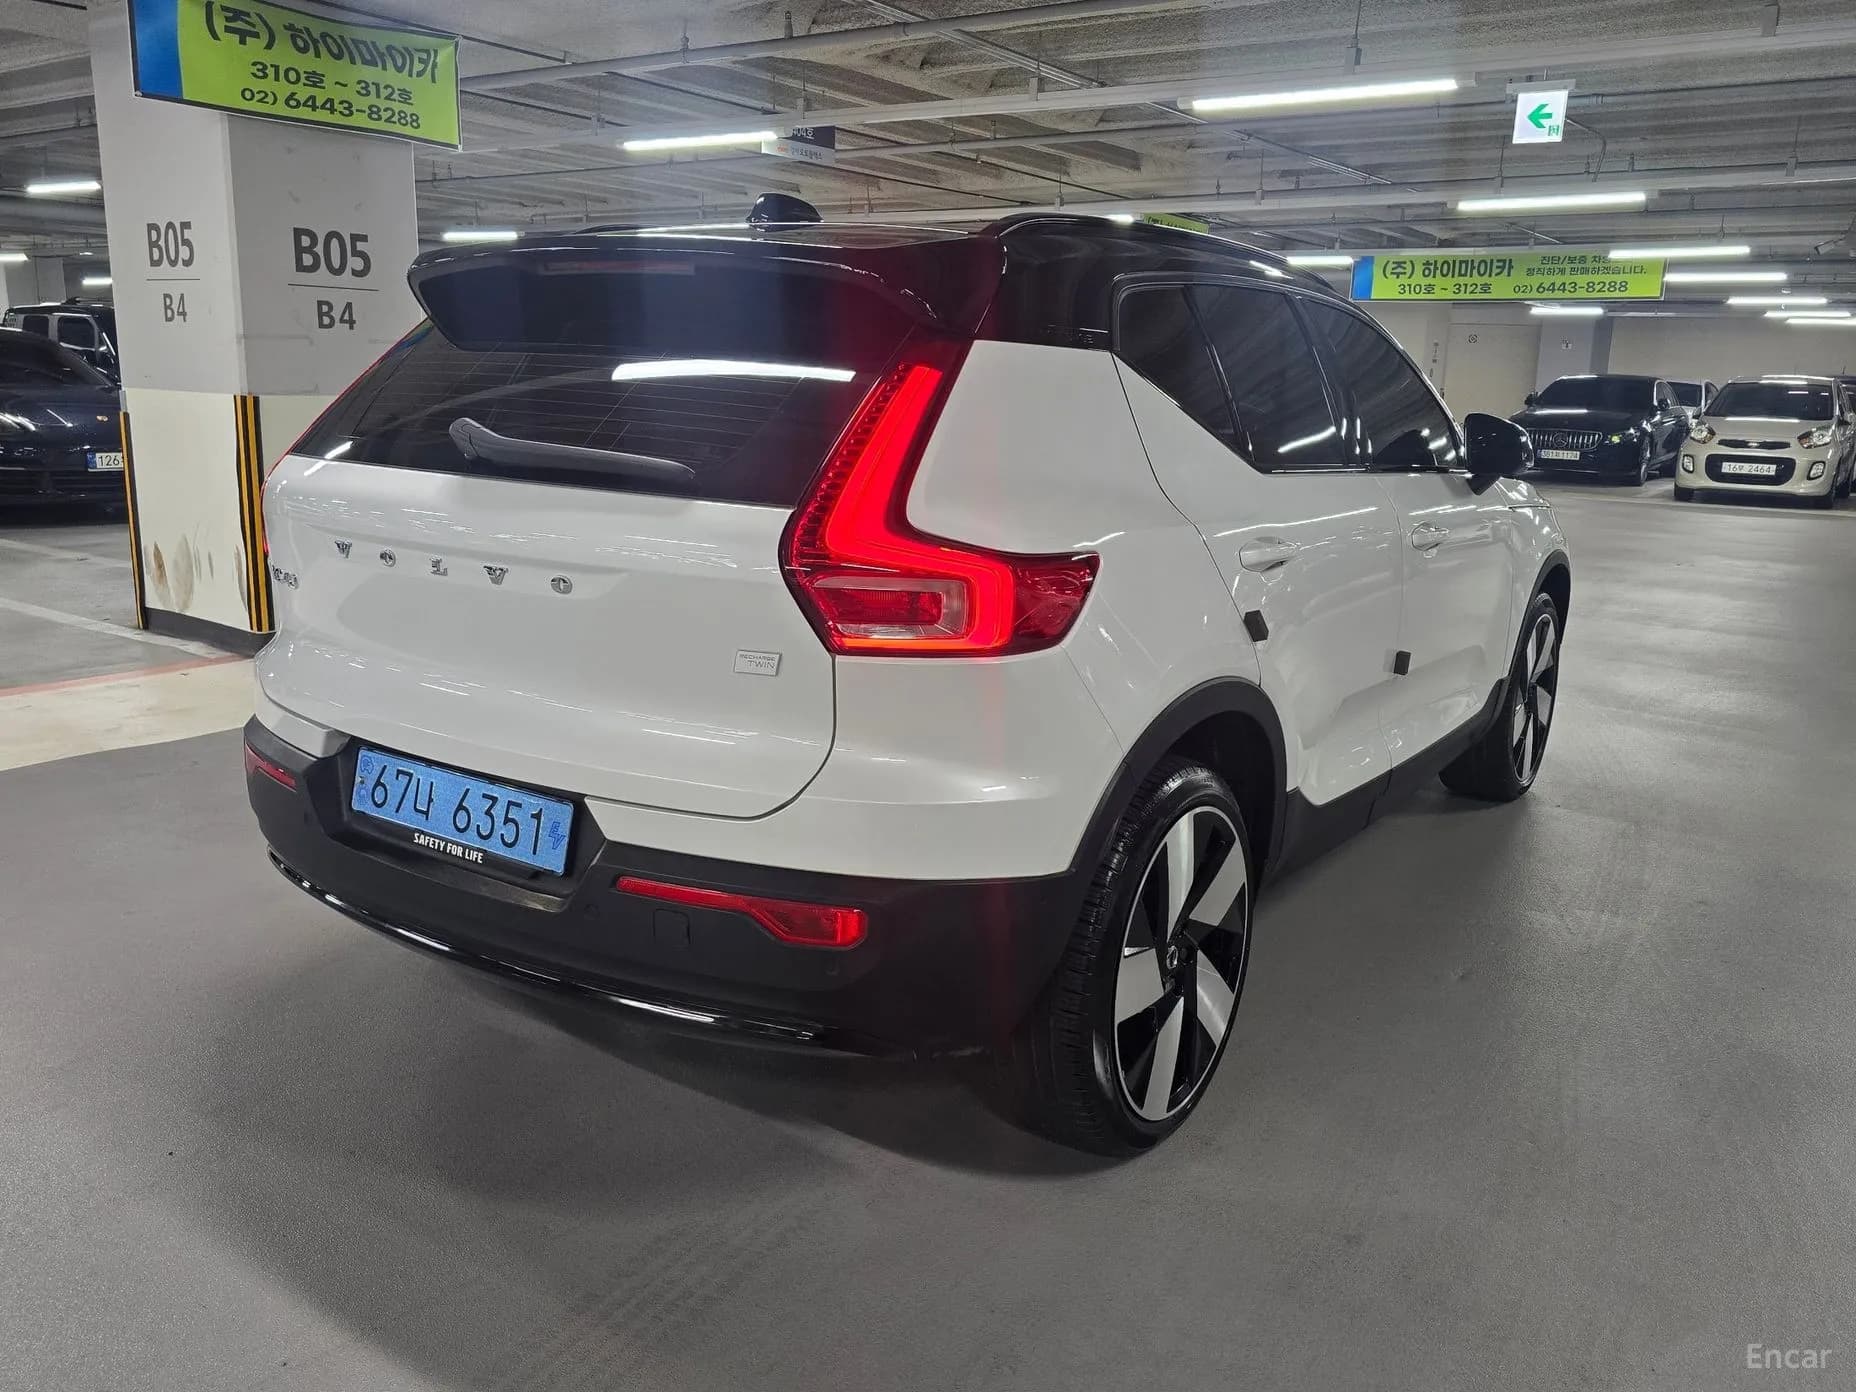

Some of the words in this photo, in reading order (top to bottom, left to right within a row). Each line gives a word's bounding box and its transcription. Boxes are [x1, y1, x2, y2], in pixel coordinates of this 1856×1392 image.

[204, 0, 276, 50] (주)
[283, 22, 438, 84] 하이마이카
[250, 61, 326, 90] 310호
[355, 79, 414, 106] 312호
[240, 88, 277, 107] 02)
[284, 91, 421, 130] 6443-8288
[146, 221, 195, 268] B05
[293, 227, 372, 278] B05
[1382, 259, 1416, 280] (주)
[1422, 258, 1514, 279] 하이마이카
[1398, 283, 1436, 295] 310호
[1453, 282, 1492, 295] 312호
[1513, 284, 1533, 294] 02)
[1536, 280, 1629, 294] 6443-8288
[163, 293, 187, 322] B4
[316, 299, 357, 331] B4
[1747, 464, 1772, 474] 2464
[334, 539, 573, 595] VOLVO
[747, 659, 777, 670] TWIN
[452, 787, 543, 855] 6351
[413, 832, 446, 851] SAFETY
[446, 842, 463, 858] FOR
[465, 848, 484, 864] LIFE
